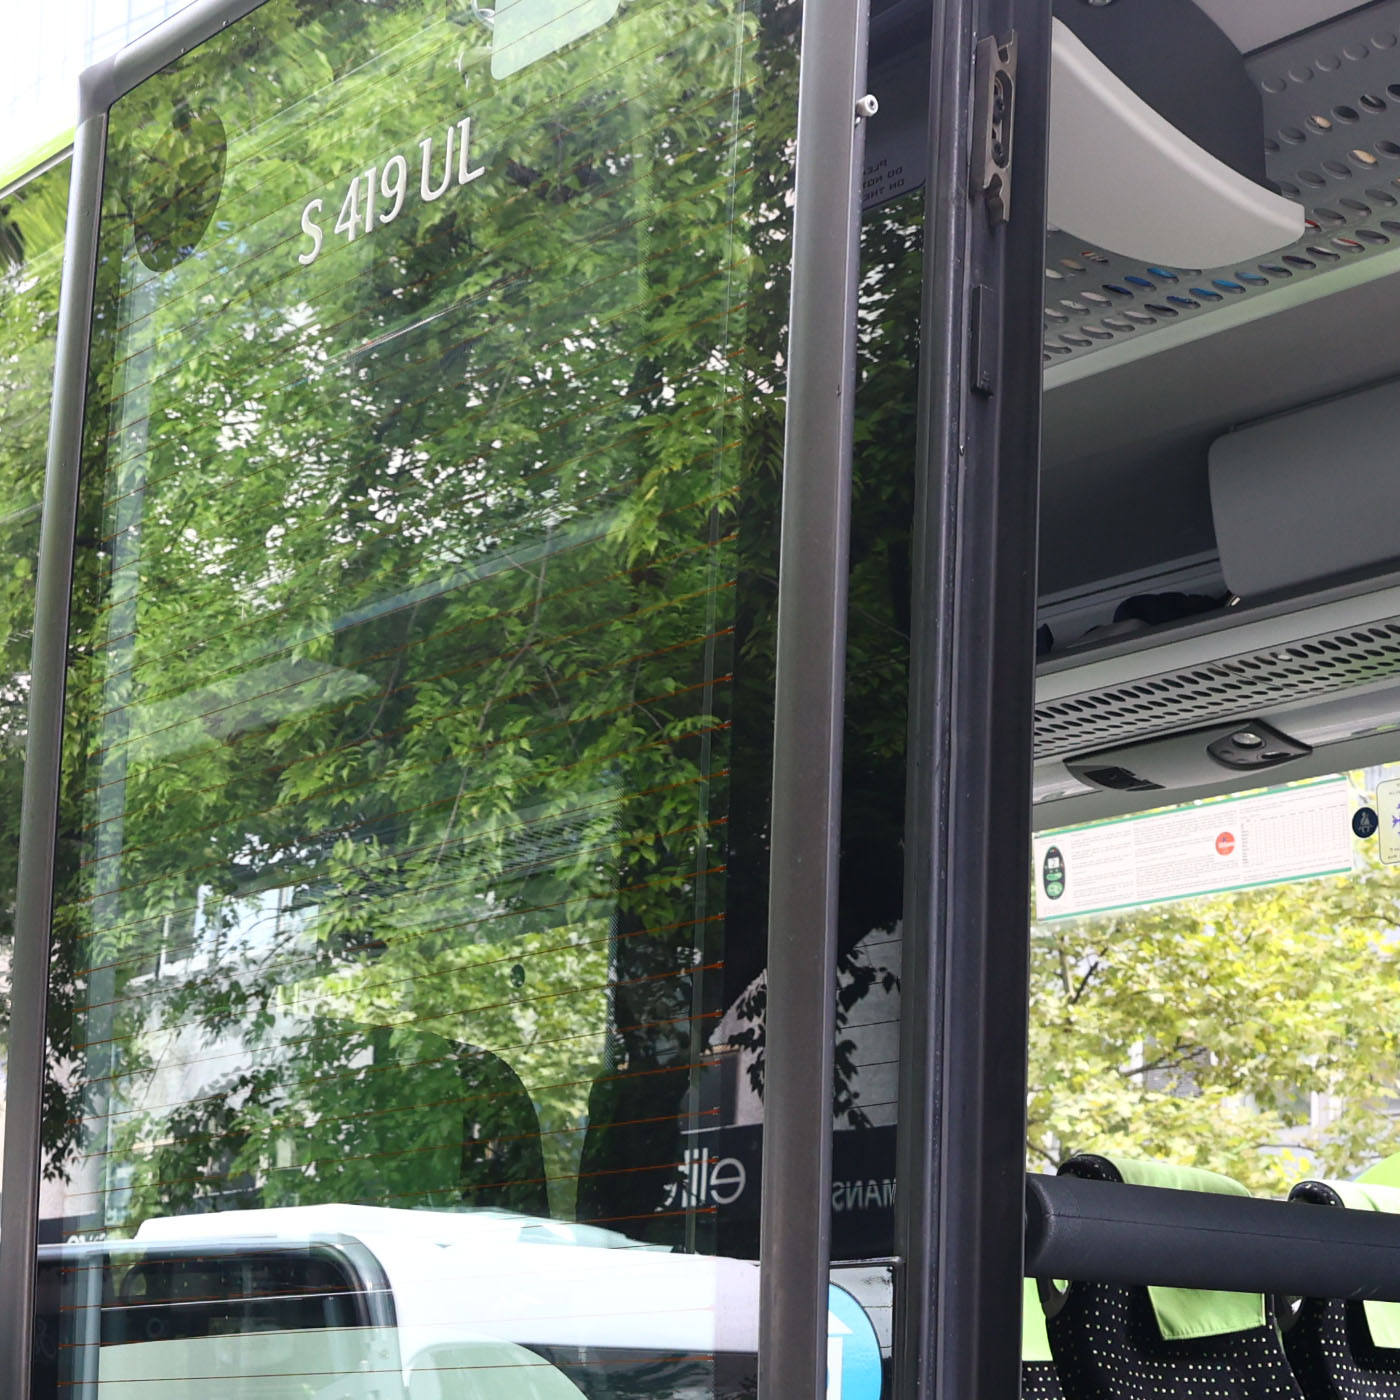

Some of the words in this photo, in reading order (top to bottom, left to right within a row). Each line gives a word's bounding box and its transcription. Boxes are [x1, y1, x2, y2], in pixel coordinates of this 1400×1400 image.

[298, 198, 323, 265] S
[334, 154, 407, 242] 419
[419, 116, 485, 202] UL
